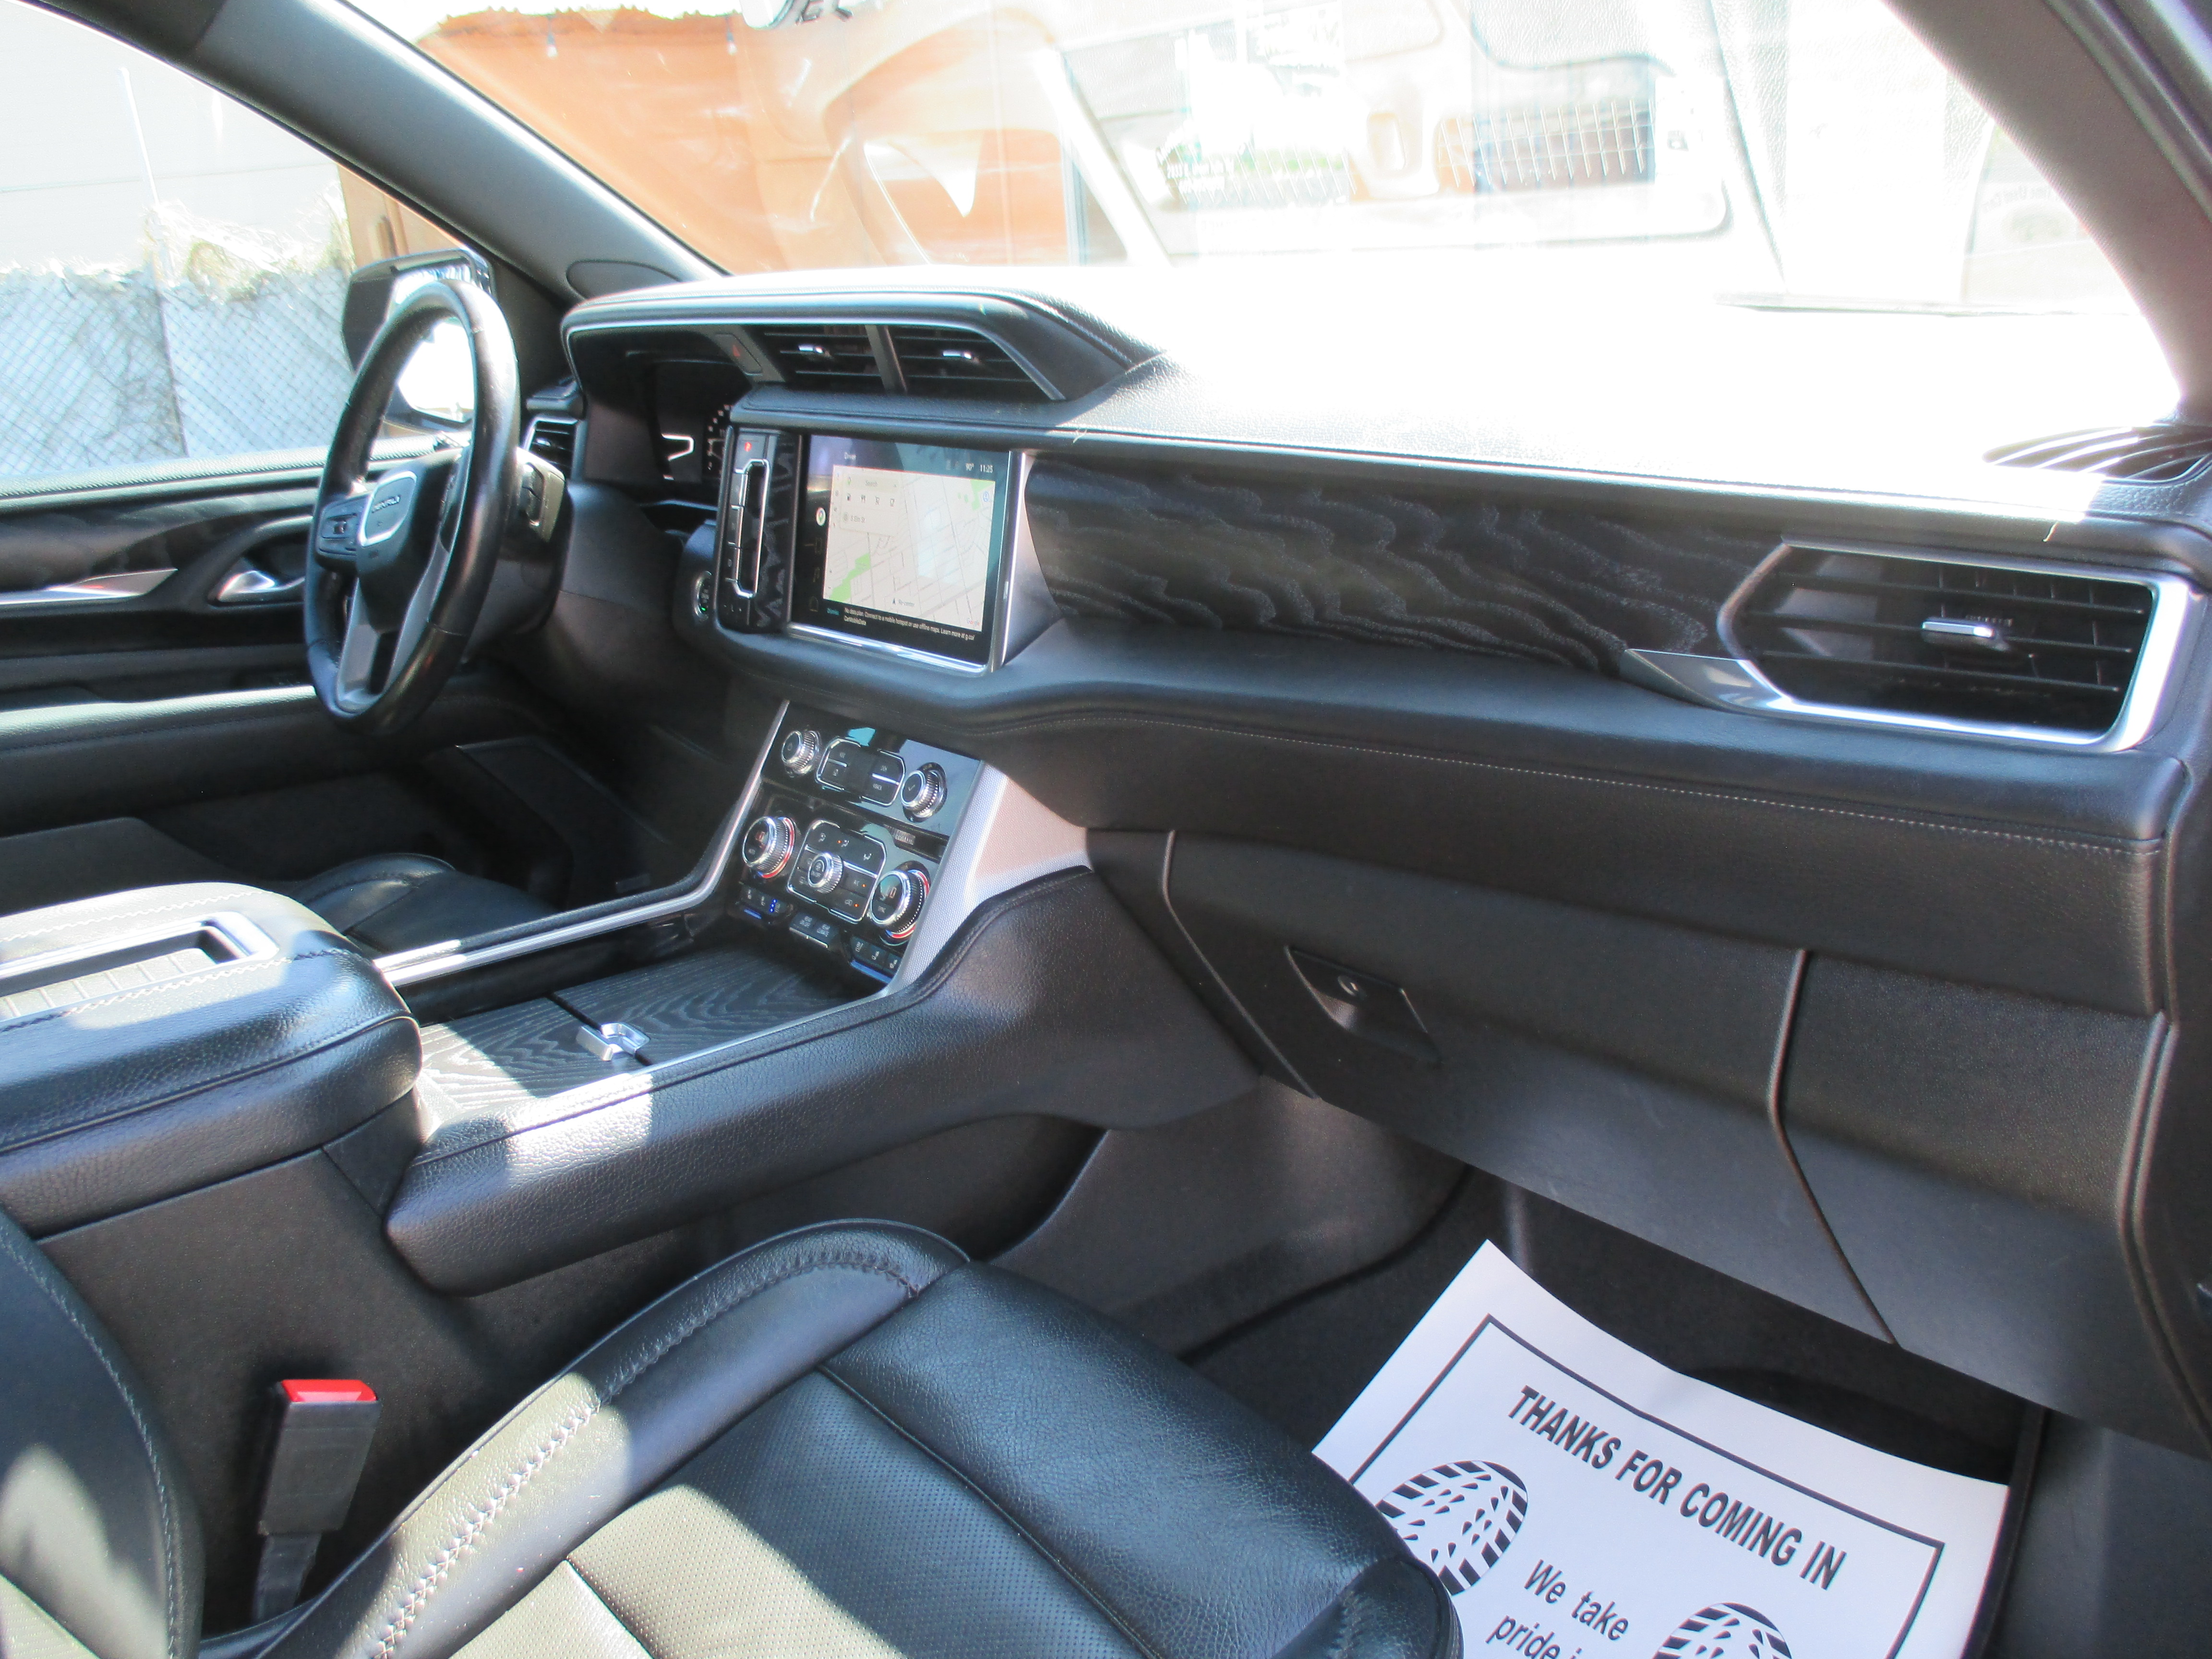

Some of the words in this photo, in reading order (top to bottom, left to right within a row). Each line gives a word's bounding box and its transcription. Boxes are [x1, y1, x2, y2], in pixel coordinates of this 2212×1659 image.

[1508, 1385, 1622, 1469] THANKS
[1614, 1449, 1683, 1505] FOR
[1680, 1482, 1803, 1566] COMING
[1799, 1540, 1848, 1591] IN
[1485, 1615, 1561, 1659] pride
[1524, 1559, 1567, 1604] We
[1571, 1590, 1629, 1641] take
